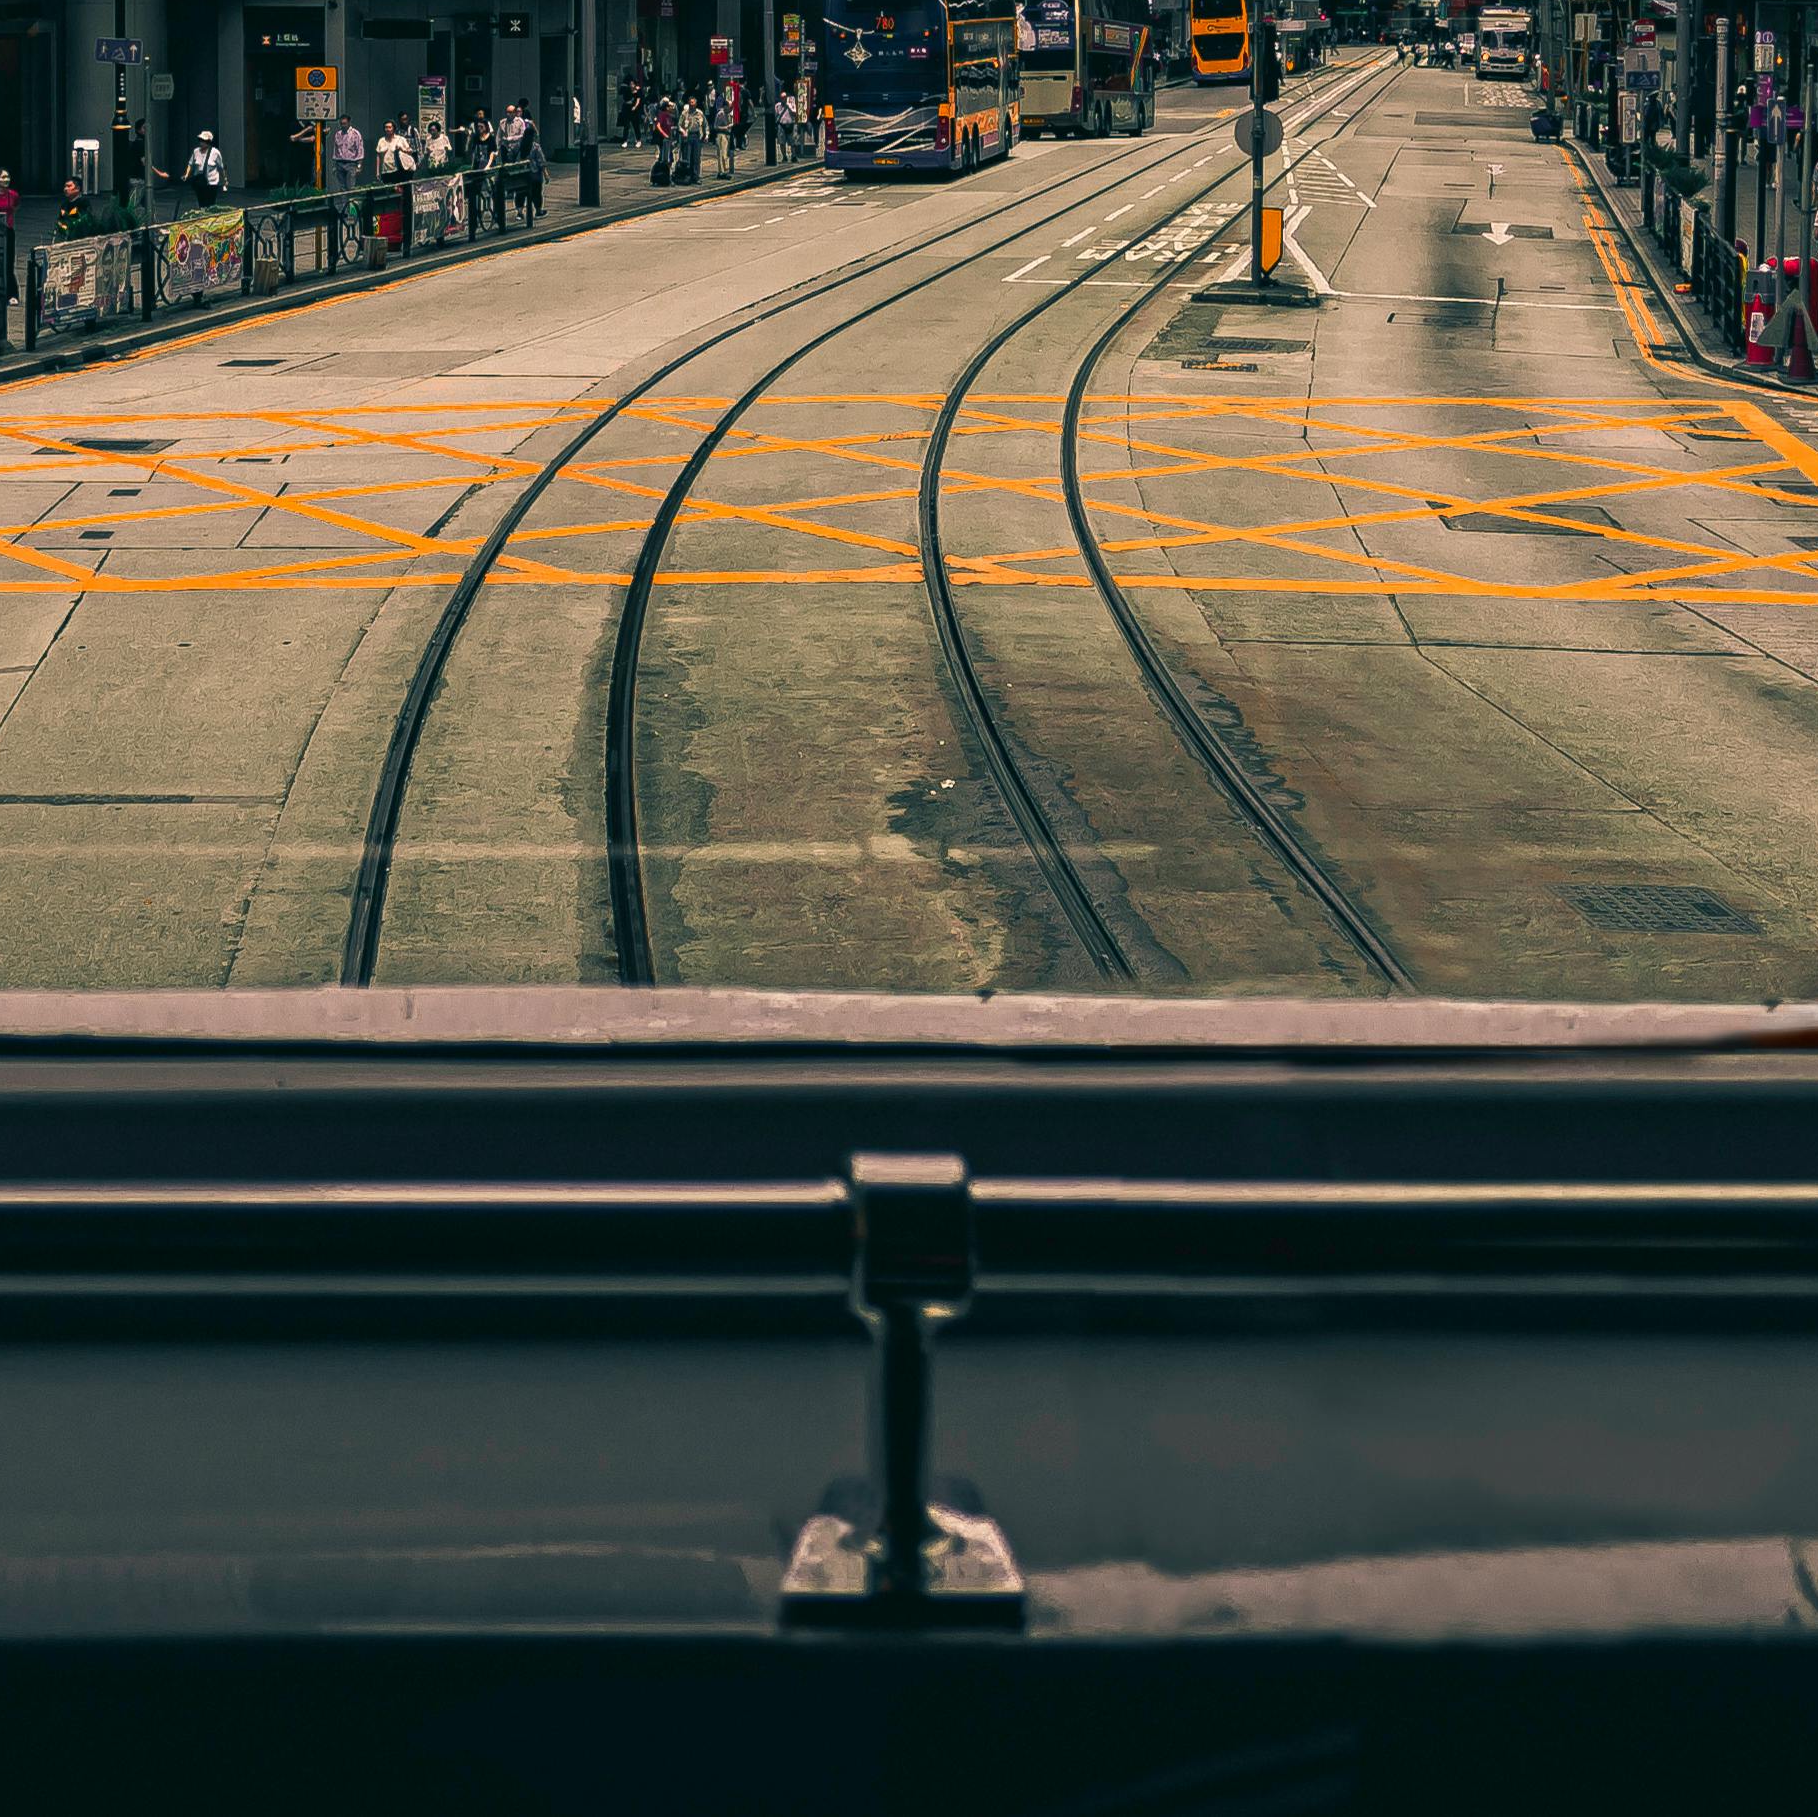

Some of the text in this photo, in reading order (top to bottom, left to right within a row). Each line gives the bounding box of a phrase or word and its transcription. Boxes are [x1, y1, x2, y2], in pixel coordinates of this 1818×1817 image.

[875, 16, 895, 31] 780
[322, 92, 331, 103] 7
[322, 107, 331, 118] 7
[1092, 238, 1241, 254] LANE
[1076, 248, 1225, 264] TRAM
